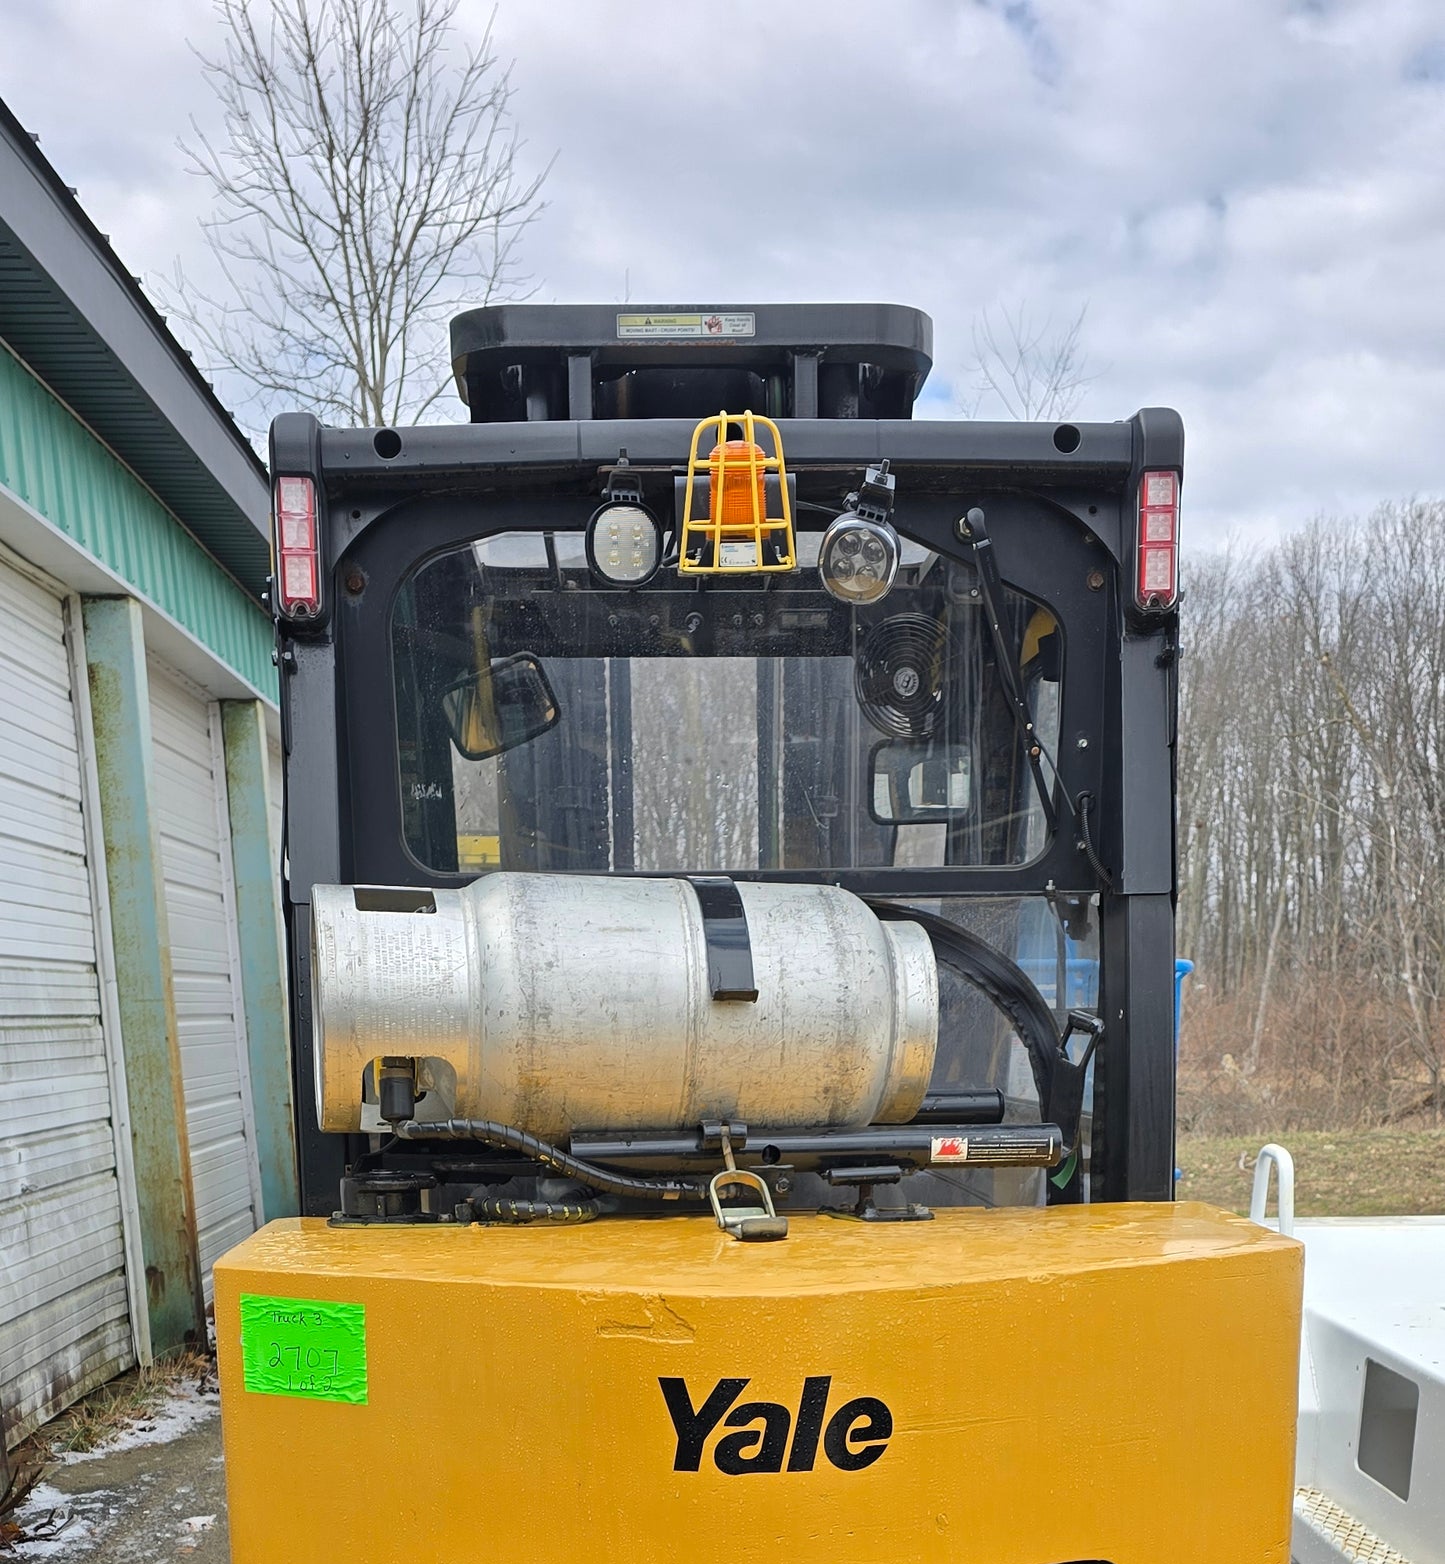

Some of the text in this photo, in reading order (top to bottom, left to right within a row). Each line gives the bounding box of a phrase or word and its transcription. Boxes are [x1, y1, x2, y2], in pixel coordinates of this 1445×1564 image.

[267, 1310, 322, 1327] Truck 3
[268, 1342, 338, 1376] 2707
[287, 1374, 333, 1392] 1 of 2
[657, 1375, 893, 1475] Yale
